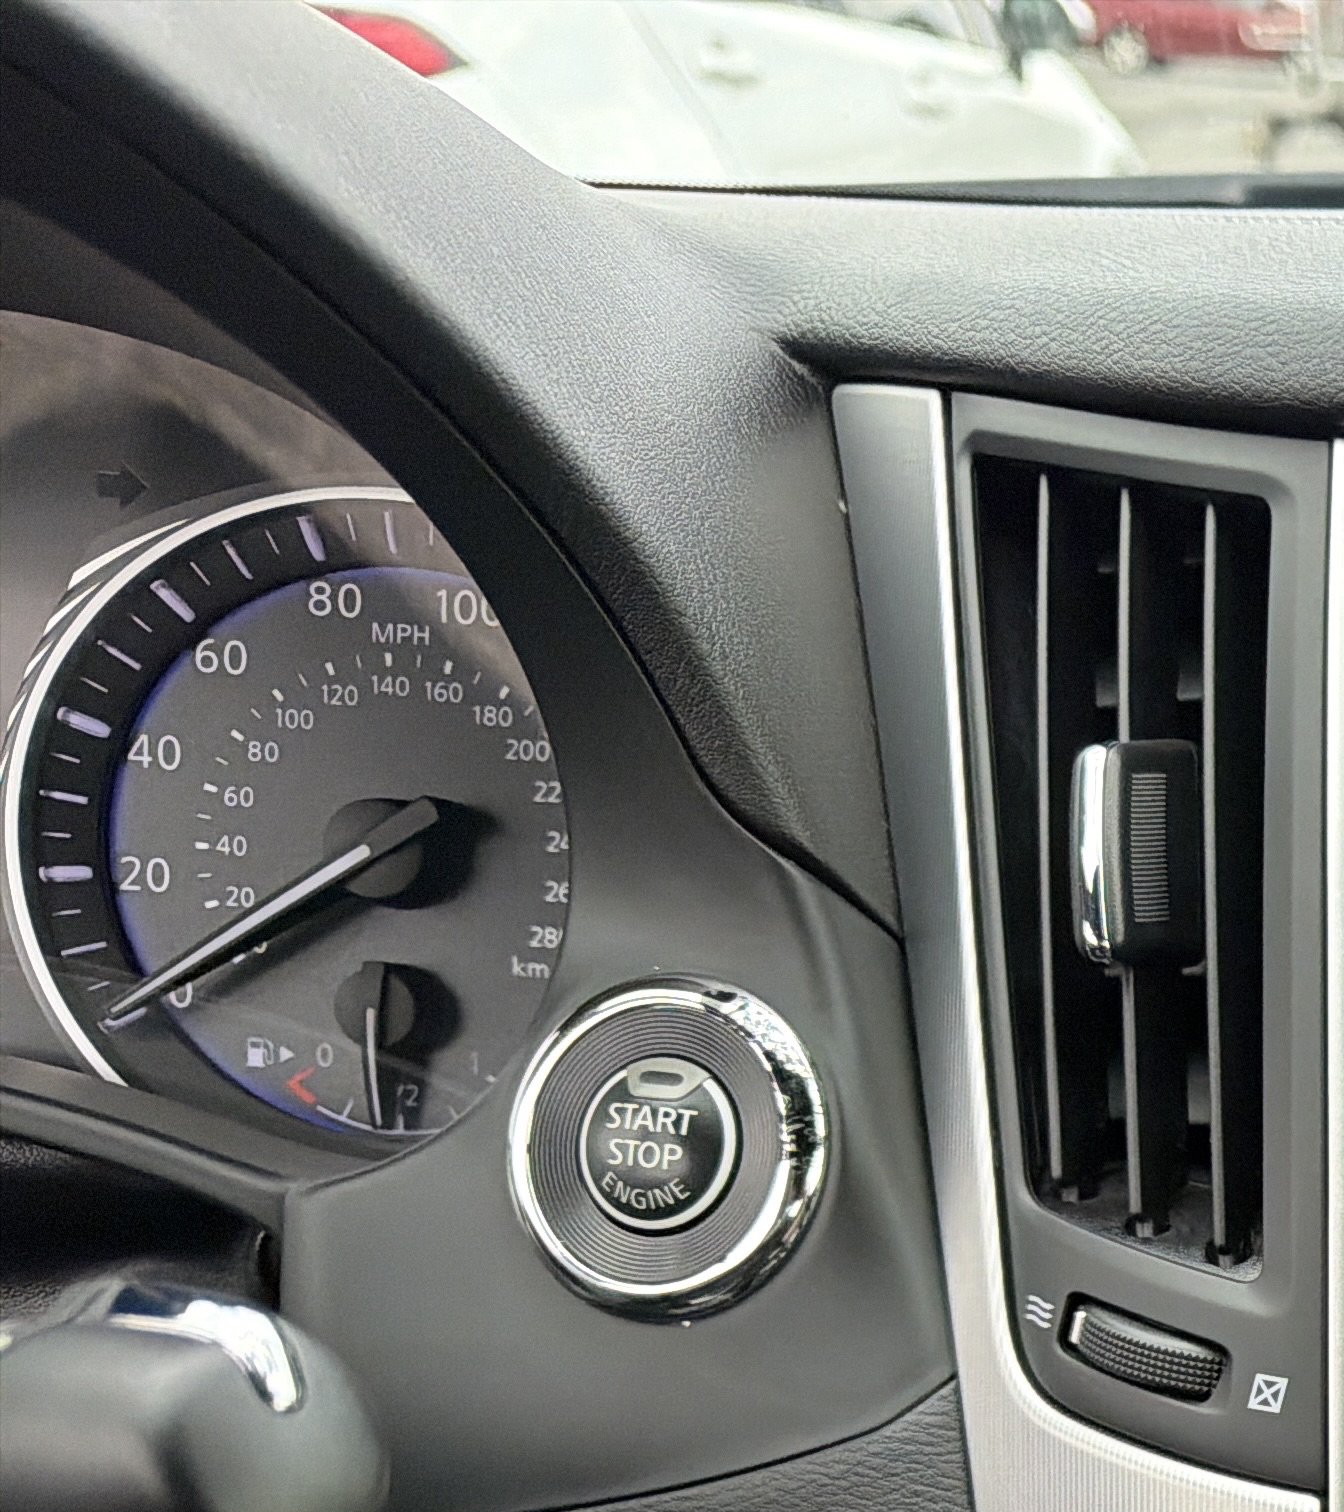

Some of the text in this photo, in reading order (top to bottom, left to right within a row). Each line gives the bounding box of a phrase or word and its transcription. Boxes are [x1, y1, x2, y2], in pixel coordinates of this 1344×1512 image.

[308, 581, 362, 618] 80
[436, 588, 500, 627] 100
[372, 622, 430, 645] MPH
[195, 638, 248, 676] 60
[321, 684, 358, 706] 120
[371, 675, 410, 697] 140
[425, 681, 463, 703] 160
[275, 708, 314, 729] 100
[472, 705, 513, 727] 180
[127, 734, 181, 770] 40
[247, 741, 280, 763] 80
[504, 739, 550, 762] 200
[223, 786, 254, 807] 60
[216, 835, 247, 857] 40
[119, 856, 170, 893] 20
[225, 886, 255, 908] 20
[529, 925, 563, 949] 28
[511, 955, 550, 979] km
[316, 1042, 333, 1068] 0
[605, 1102, 698, 1136] START
[607, 1138, 683, 1170] STOP
[601, 1171, 692, 1210] ENGINE
